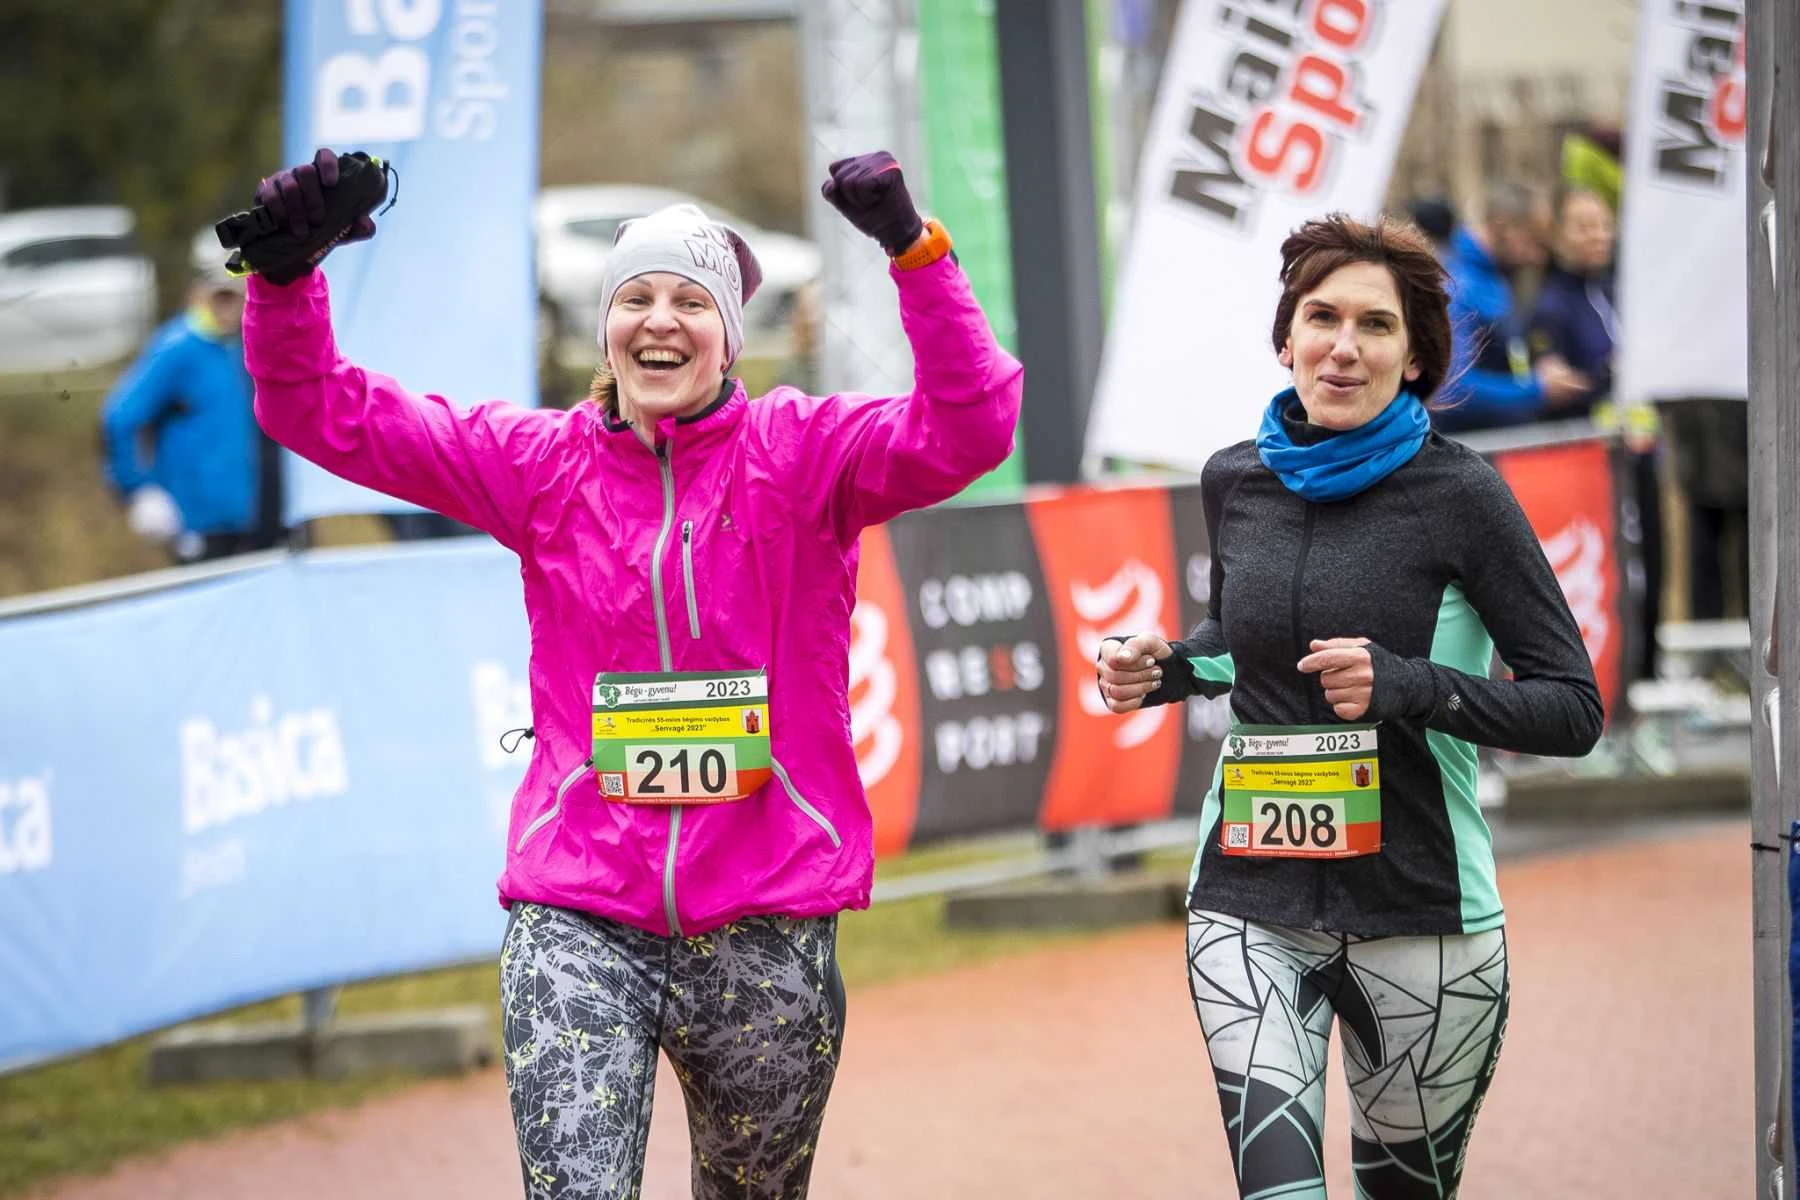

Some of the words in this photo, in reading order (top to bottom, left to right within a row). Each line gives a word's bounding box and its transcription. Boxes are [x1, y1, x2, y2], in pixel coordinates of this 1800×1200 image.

[1170, 0, 1298, 220] Mai
[920, 570, 1032, 629] COMP
[648, 684, 676, 697] gyvenu!
[705, 680, 751, 698] 2023
[181, 692, 348, 834] Basica
[935, 711, 1043, 773] PORT
[1315, 734, 1361, 752] 2023
[636, 748, 727, 794] 210
[1260, 802, 1337, 848] 208
